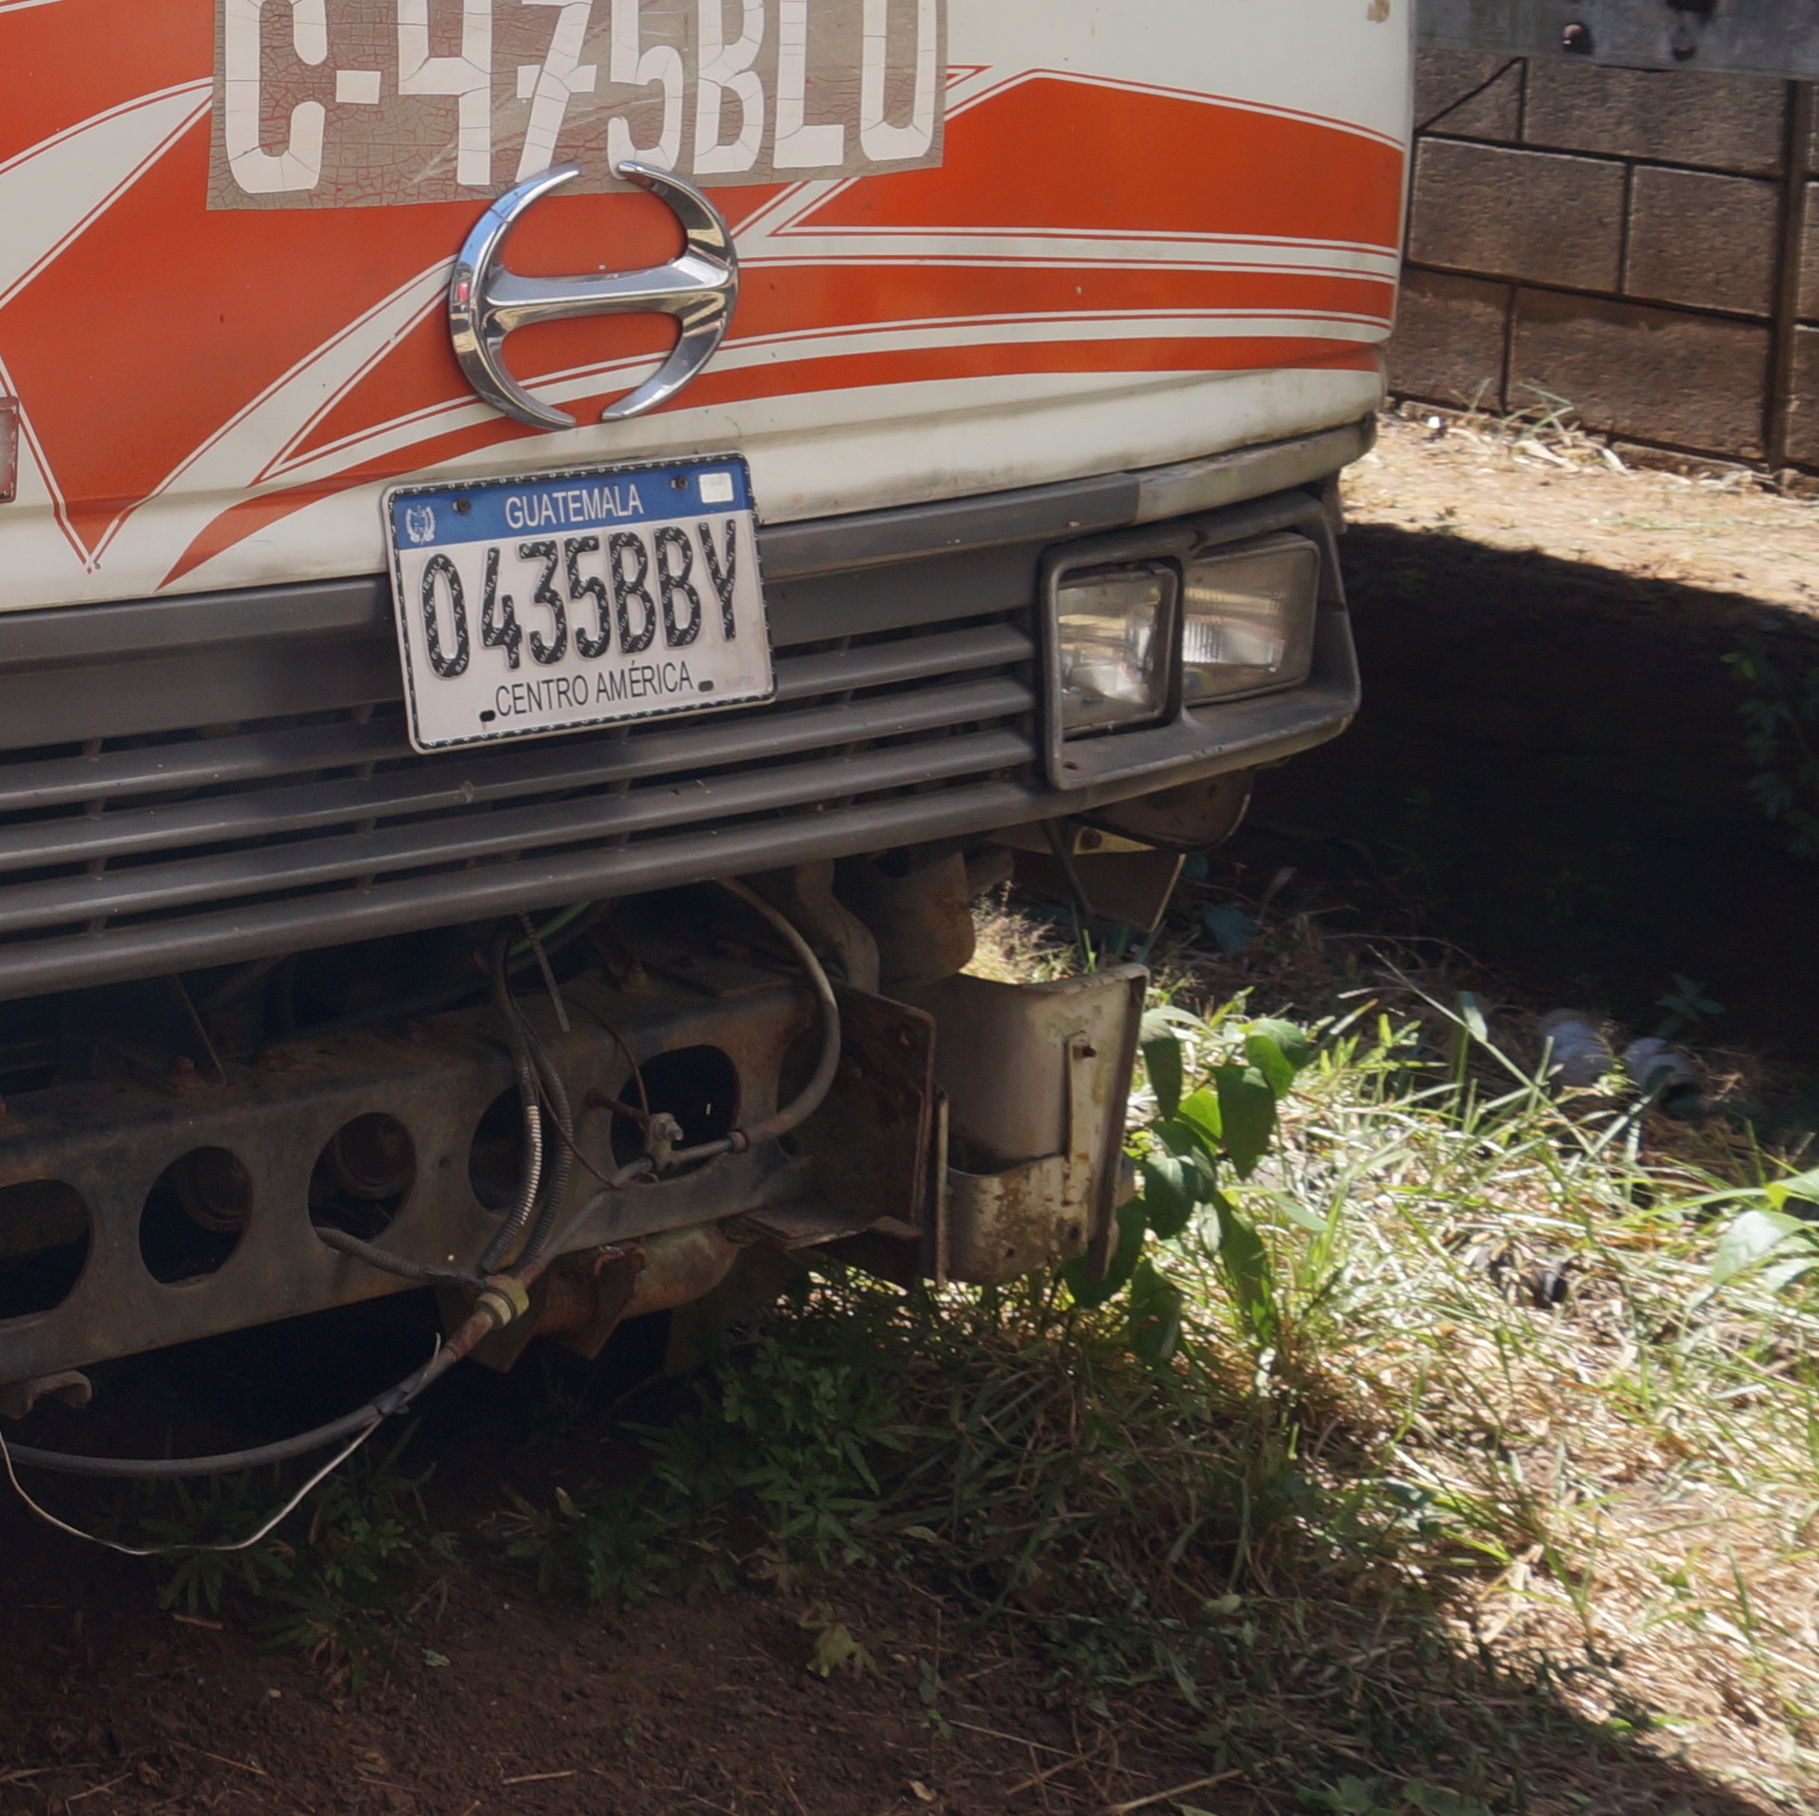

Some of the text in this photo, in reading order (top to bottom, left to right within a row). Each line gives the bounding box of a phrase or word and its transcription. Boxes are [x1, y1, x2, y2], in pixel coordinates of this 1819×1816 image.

[505, 483, 644, 529] GUATEMALA
[495, 660, 694, 718] CENTRO AMÉRICA
